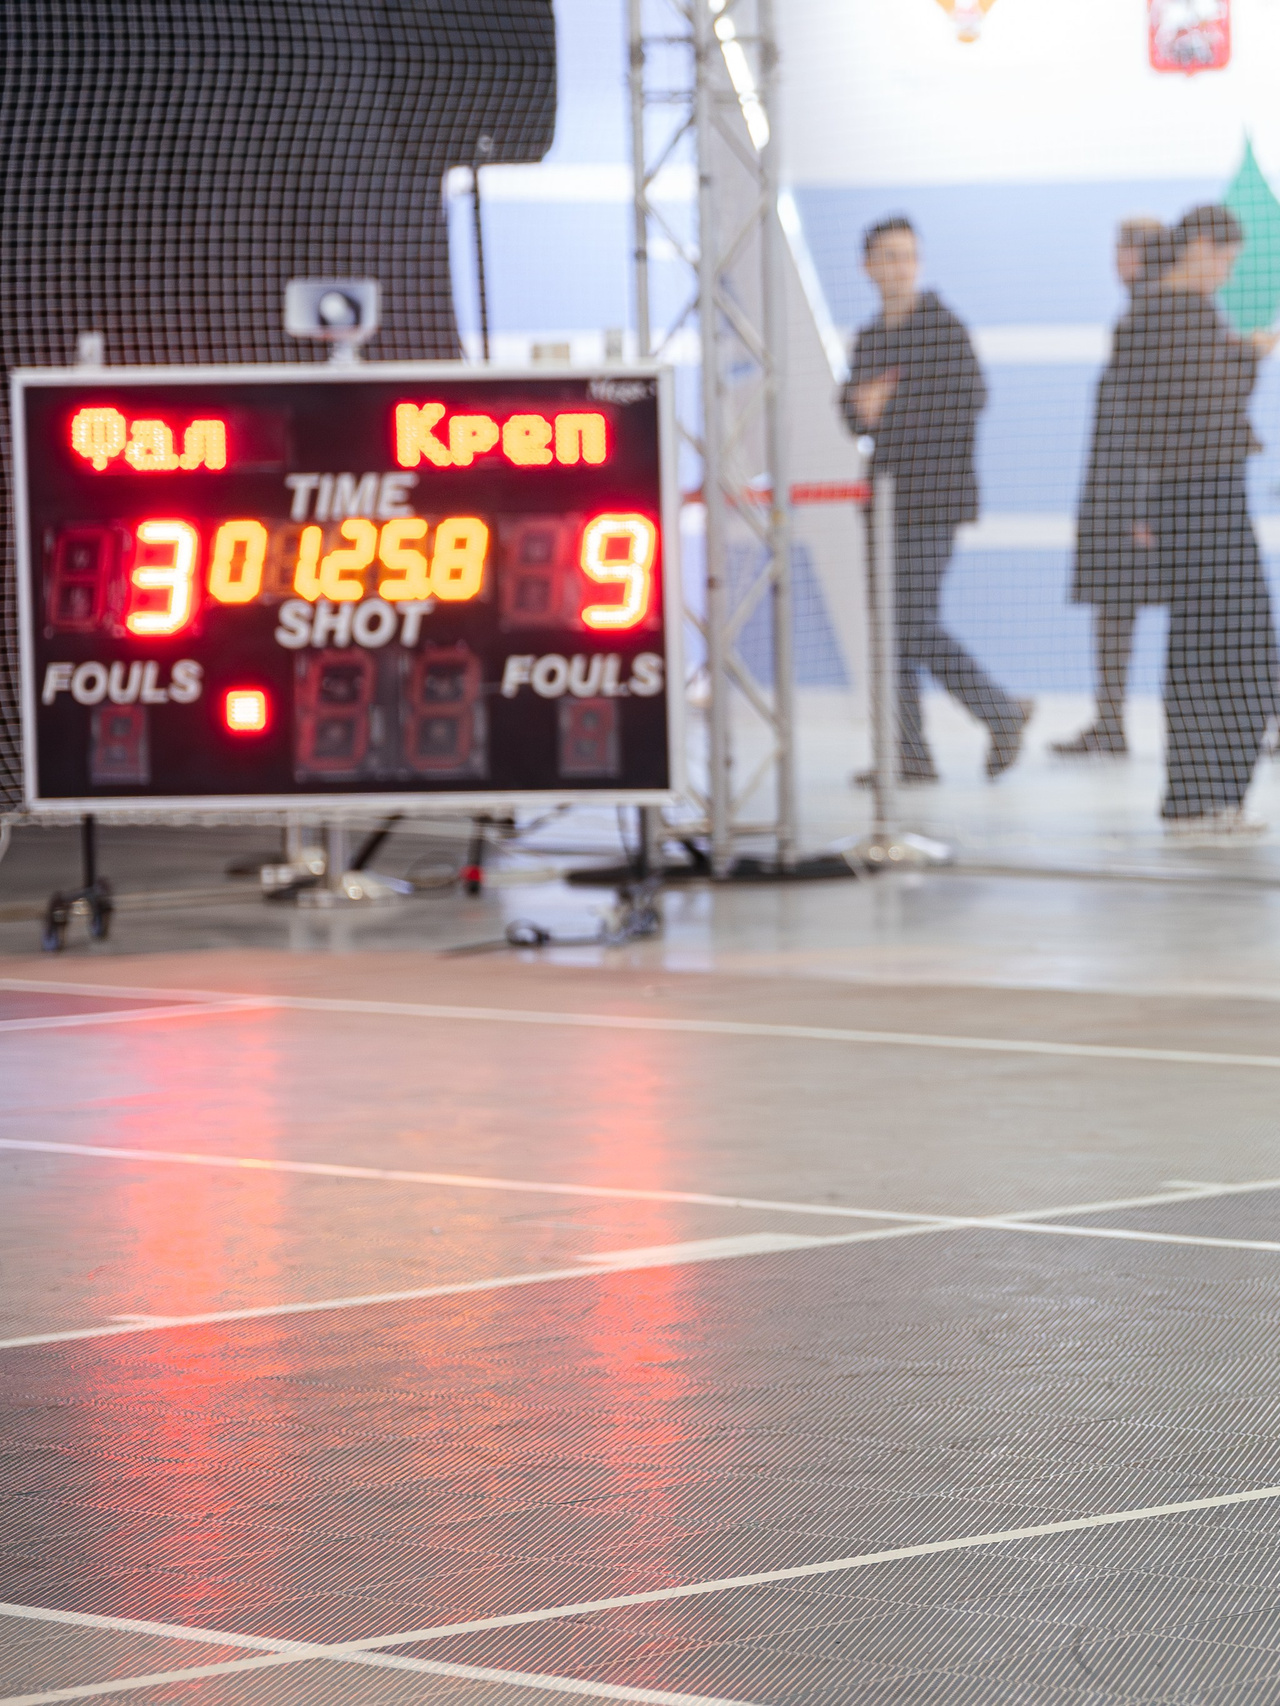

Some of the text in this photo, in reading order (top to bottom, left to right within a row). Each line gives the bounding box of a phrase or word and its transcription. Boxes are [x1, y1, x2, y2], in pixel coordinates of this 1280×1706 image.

[70, 406, 227, 471] Фал
[394, 401, 608, 468] Креп
[285, 473, 420, 521] TIME
[125, 518, 199, 636] 3
[580, 512, 656, 630] 9
[274, 599, 434, 648] SHOT
[42, 659, 204, 705] FOULS
[501, 652, 664, 699] FOULS
